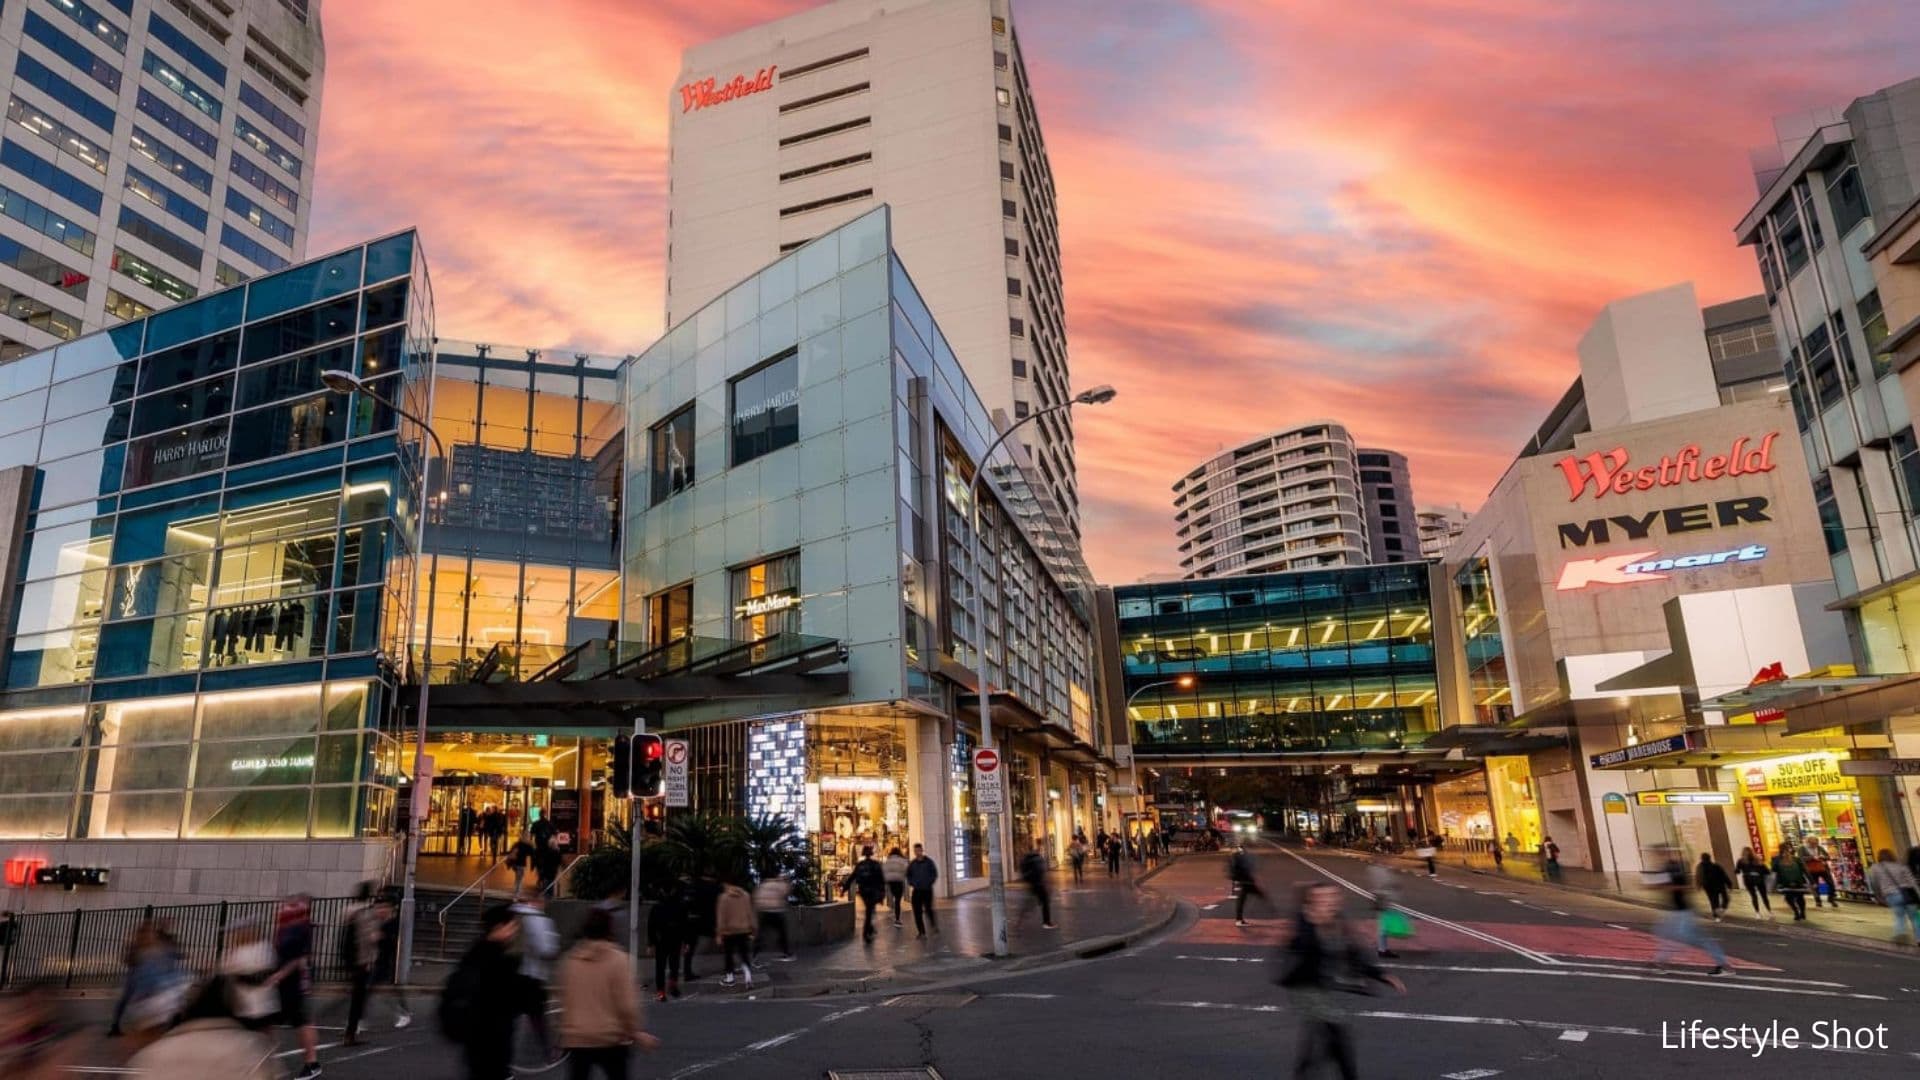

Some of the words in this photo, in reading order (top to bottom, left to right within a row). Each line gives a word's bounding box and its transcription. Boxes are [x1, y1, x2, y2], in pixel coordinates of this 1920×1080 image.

[679, 64, 777, 114] Westfield
[153, 445, 186, 464] HARRY
[1553, 432, 1780, 502] Westfield
[1557, 496, 1773, 549] MYER
[1556, 543, 1768, 591] Kmart
[670, 765, 683, 775] NO
[1771, 772, 1840, 789] PRESCRIPTIONS
[1804, 758, 1827, 773] OFF
